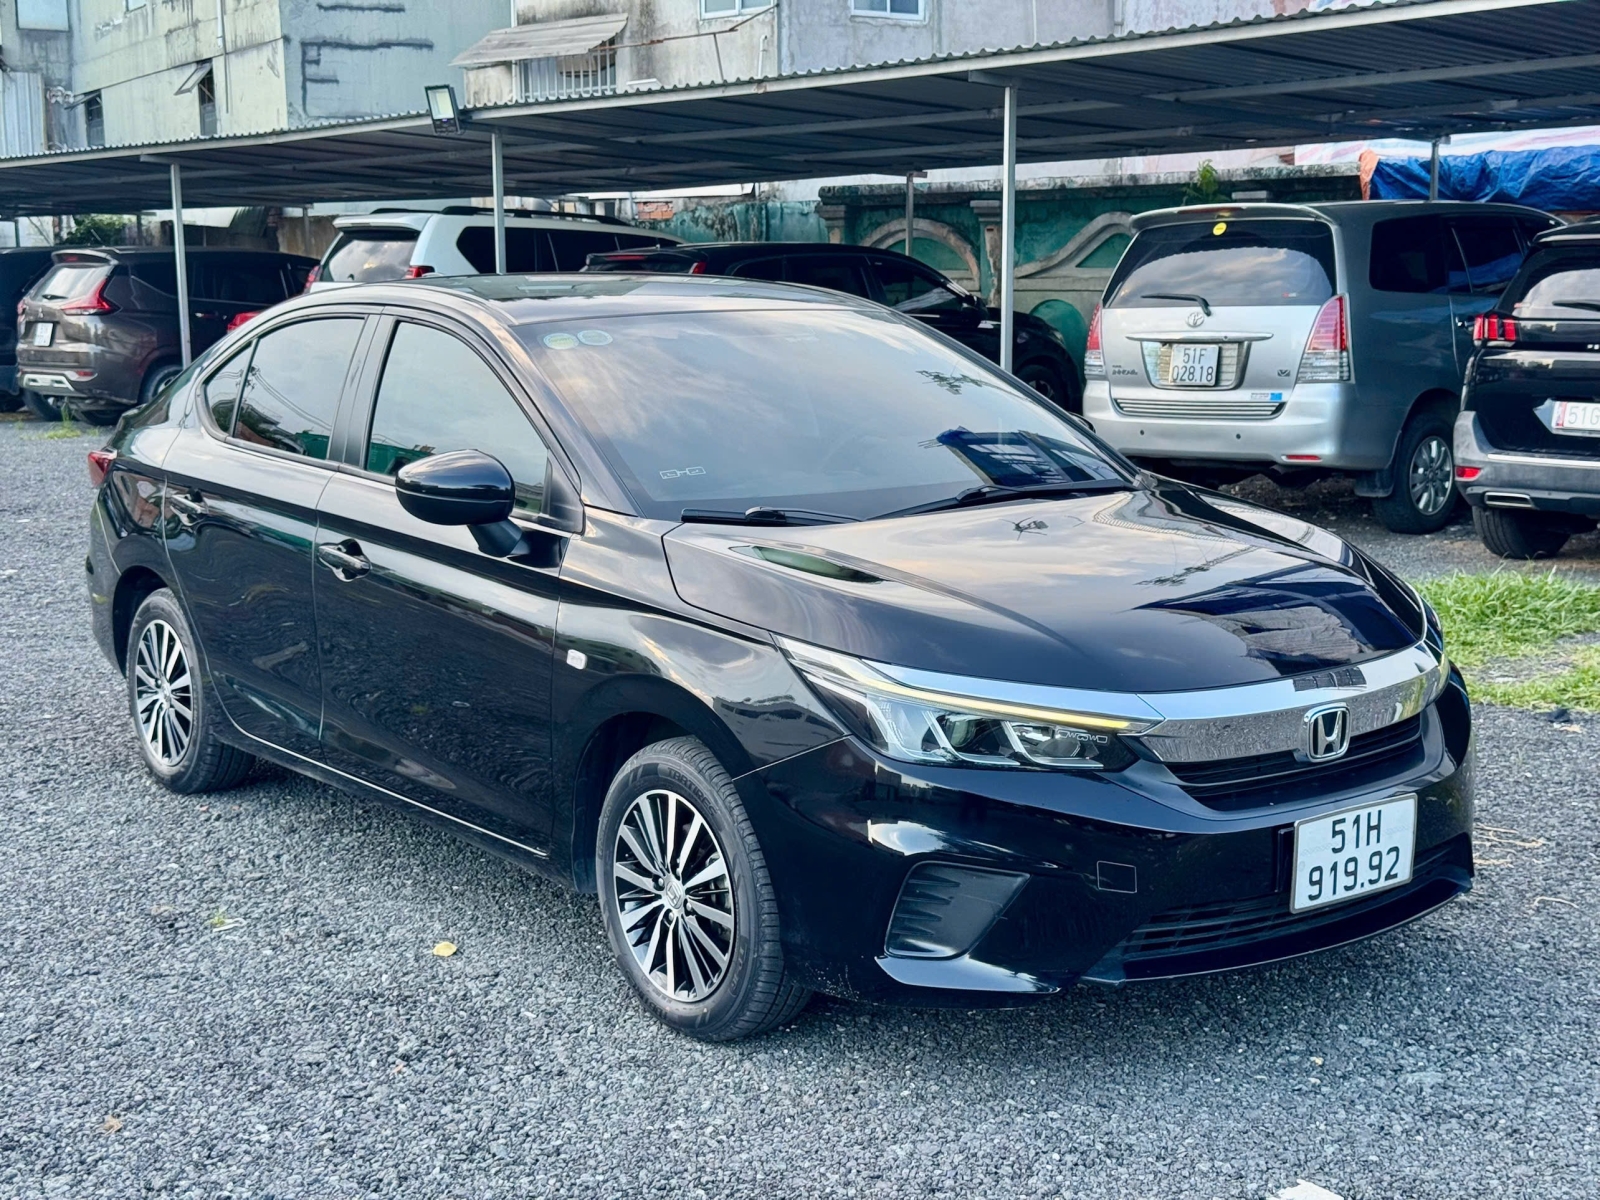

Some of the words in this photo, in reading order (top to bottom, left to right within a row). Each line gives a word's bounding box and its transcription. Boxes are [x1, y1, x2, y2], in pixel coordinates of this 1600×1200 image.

[1183, 347, 1207, 364] 51F
[1172, 365, 1214, 382] 028.18
[1331, 809, 1382, 854] 51H
[1308, 846, 1400, 901] 919.92
